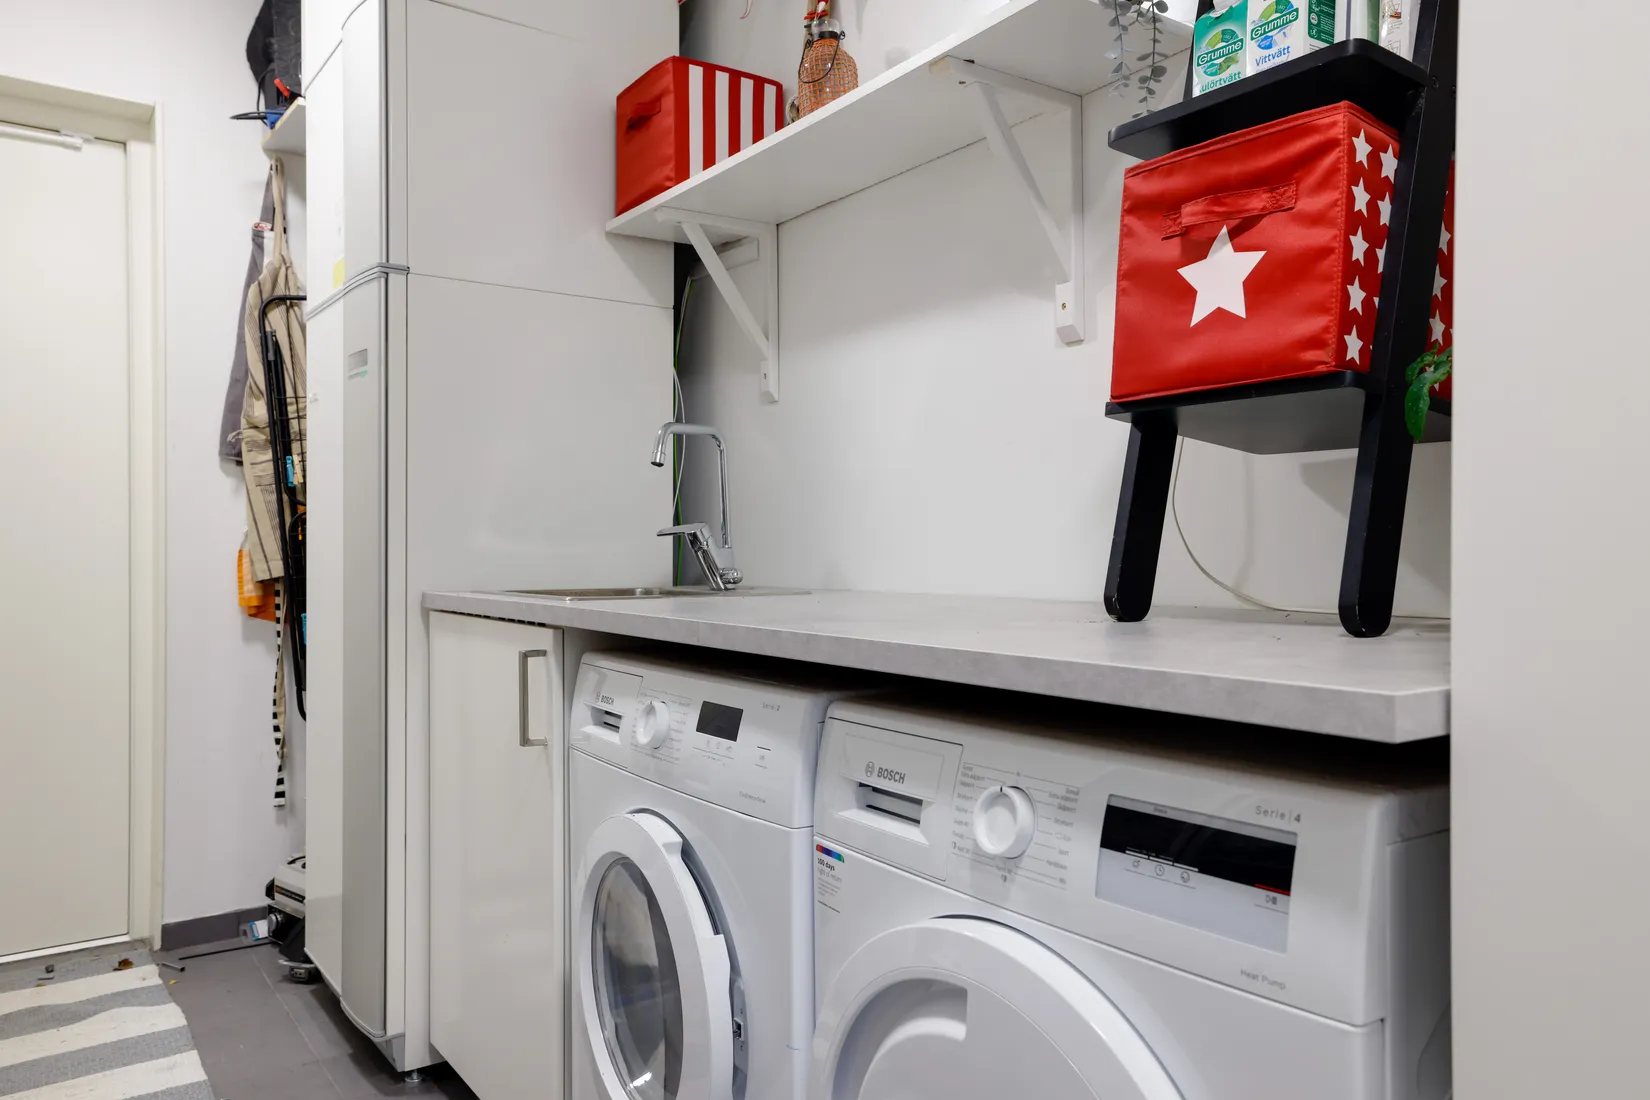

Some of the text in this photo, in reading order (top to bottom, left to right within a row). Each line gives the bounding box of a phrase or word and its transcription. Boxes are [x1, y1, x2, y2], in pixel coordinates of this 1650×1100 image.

[1251, 10, 1298, 38] Grumme
[1198, 41, 1242, 65] Grumme
[1255, 45, 1291, 67] Vittvätt
[600, 695, 614, 705] BOSCH
[876, 766, 906, 784] BOSCH
[1255, 805, 1302, 823] Serie 4
[825, 861, 836, 872] days
[1240, 969, 1287, 990] Heat Pump
